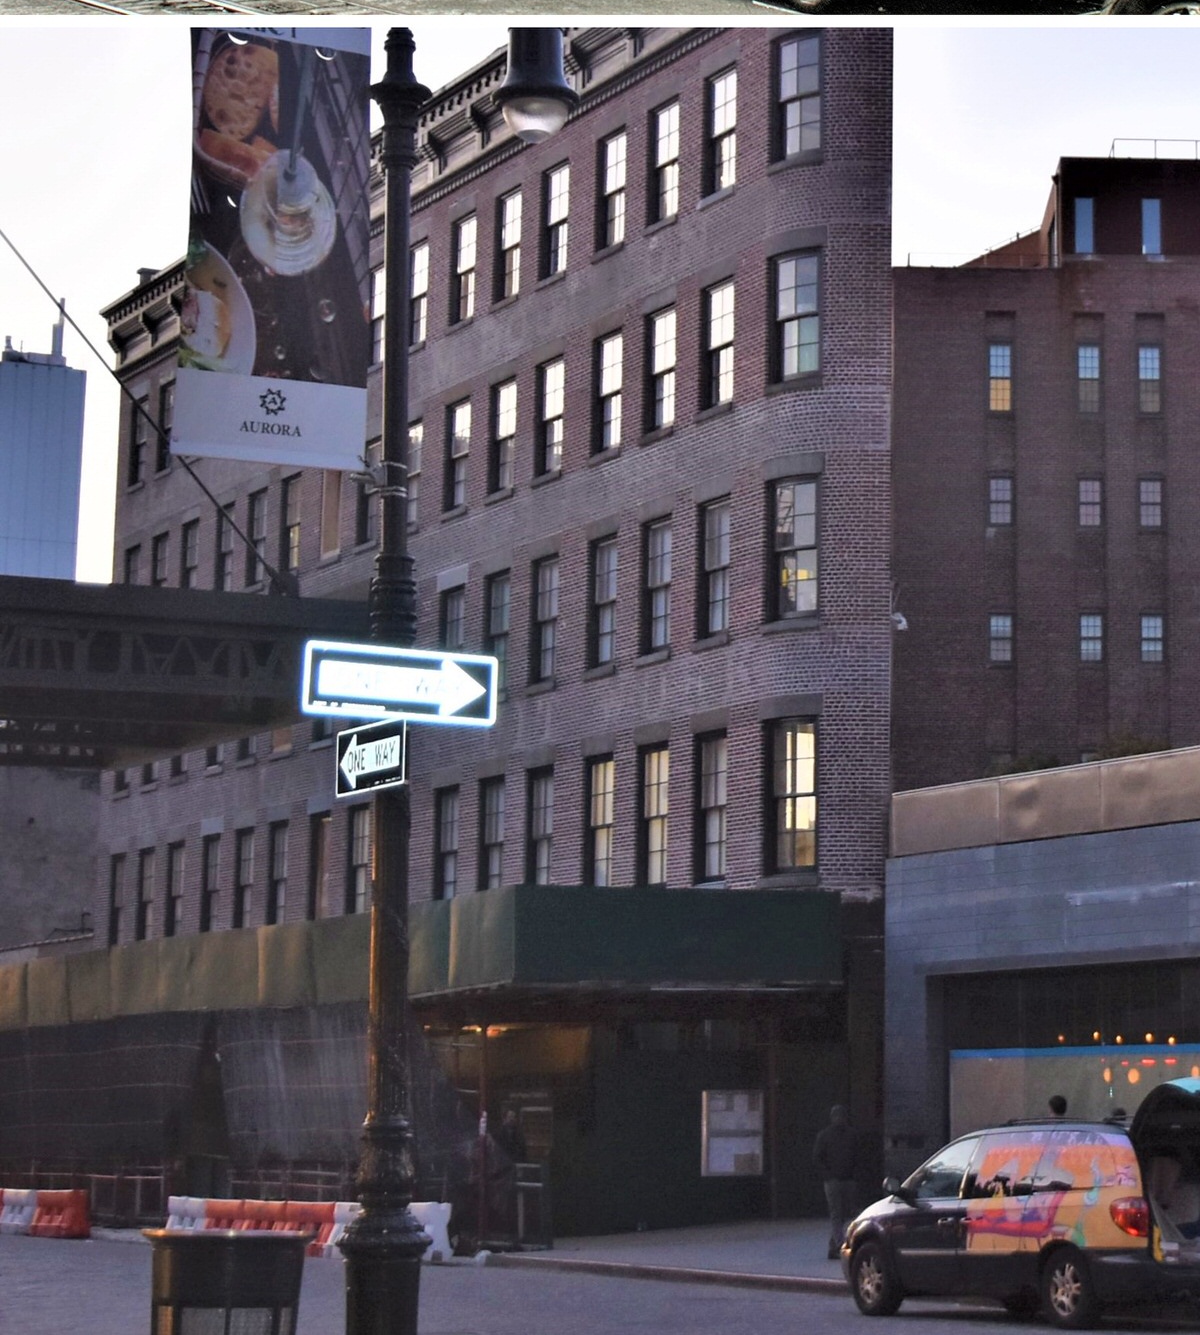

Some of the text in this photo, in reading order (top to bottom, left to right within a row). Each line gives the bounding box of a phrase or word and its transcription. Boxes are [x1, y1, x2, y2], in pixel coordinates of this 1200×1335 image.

[240, 420, 302, 437] AURORA
[347, 740, 396, 773] ONE WAY
